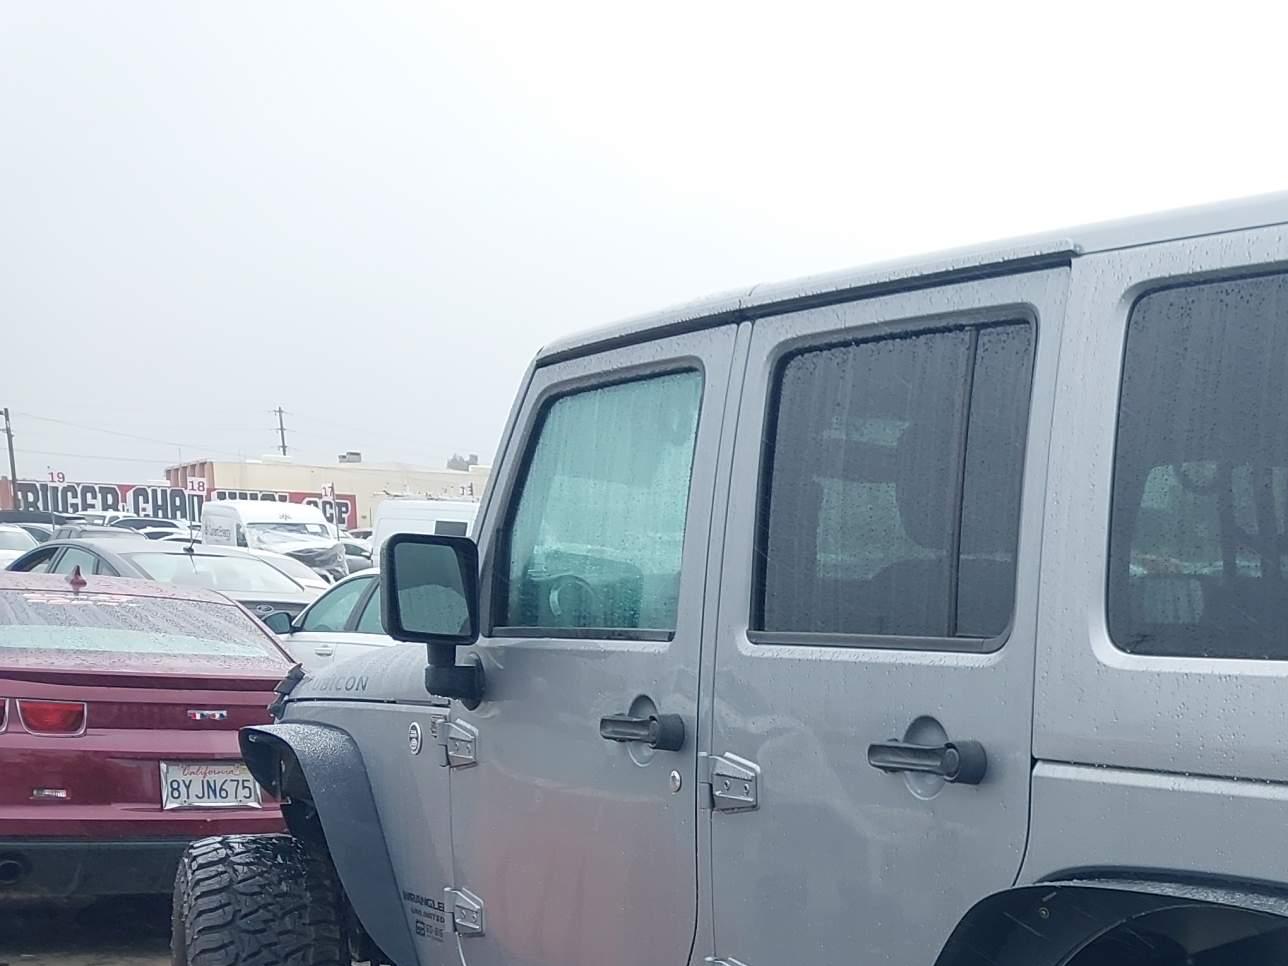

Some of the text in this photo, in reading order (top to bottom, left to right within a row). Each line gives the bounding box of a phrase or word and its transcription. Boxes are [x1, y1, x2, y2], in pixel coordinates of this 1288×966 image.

[48, 472, 66, 484] 19
[189, 481, 206, 492] 18
[182, 766, 235, 779] California
[169, 779, 253, 800] 8YJN675
